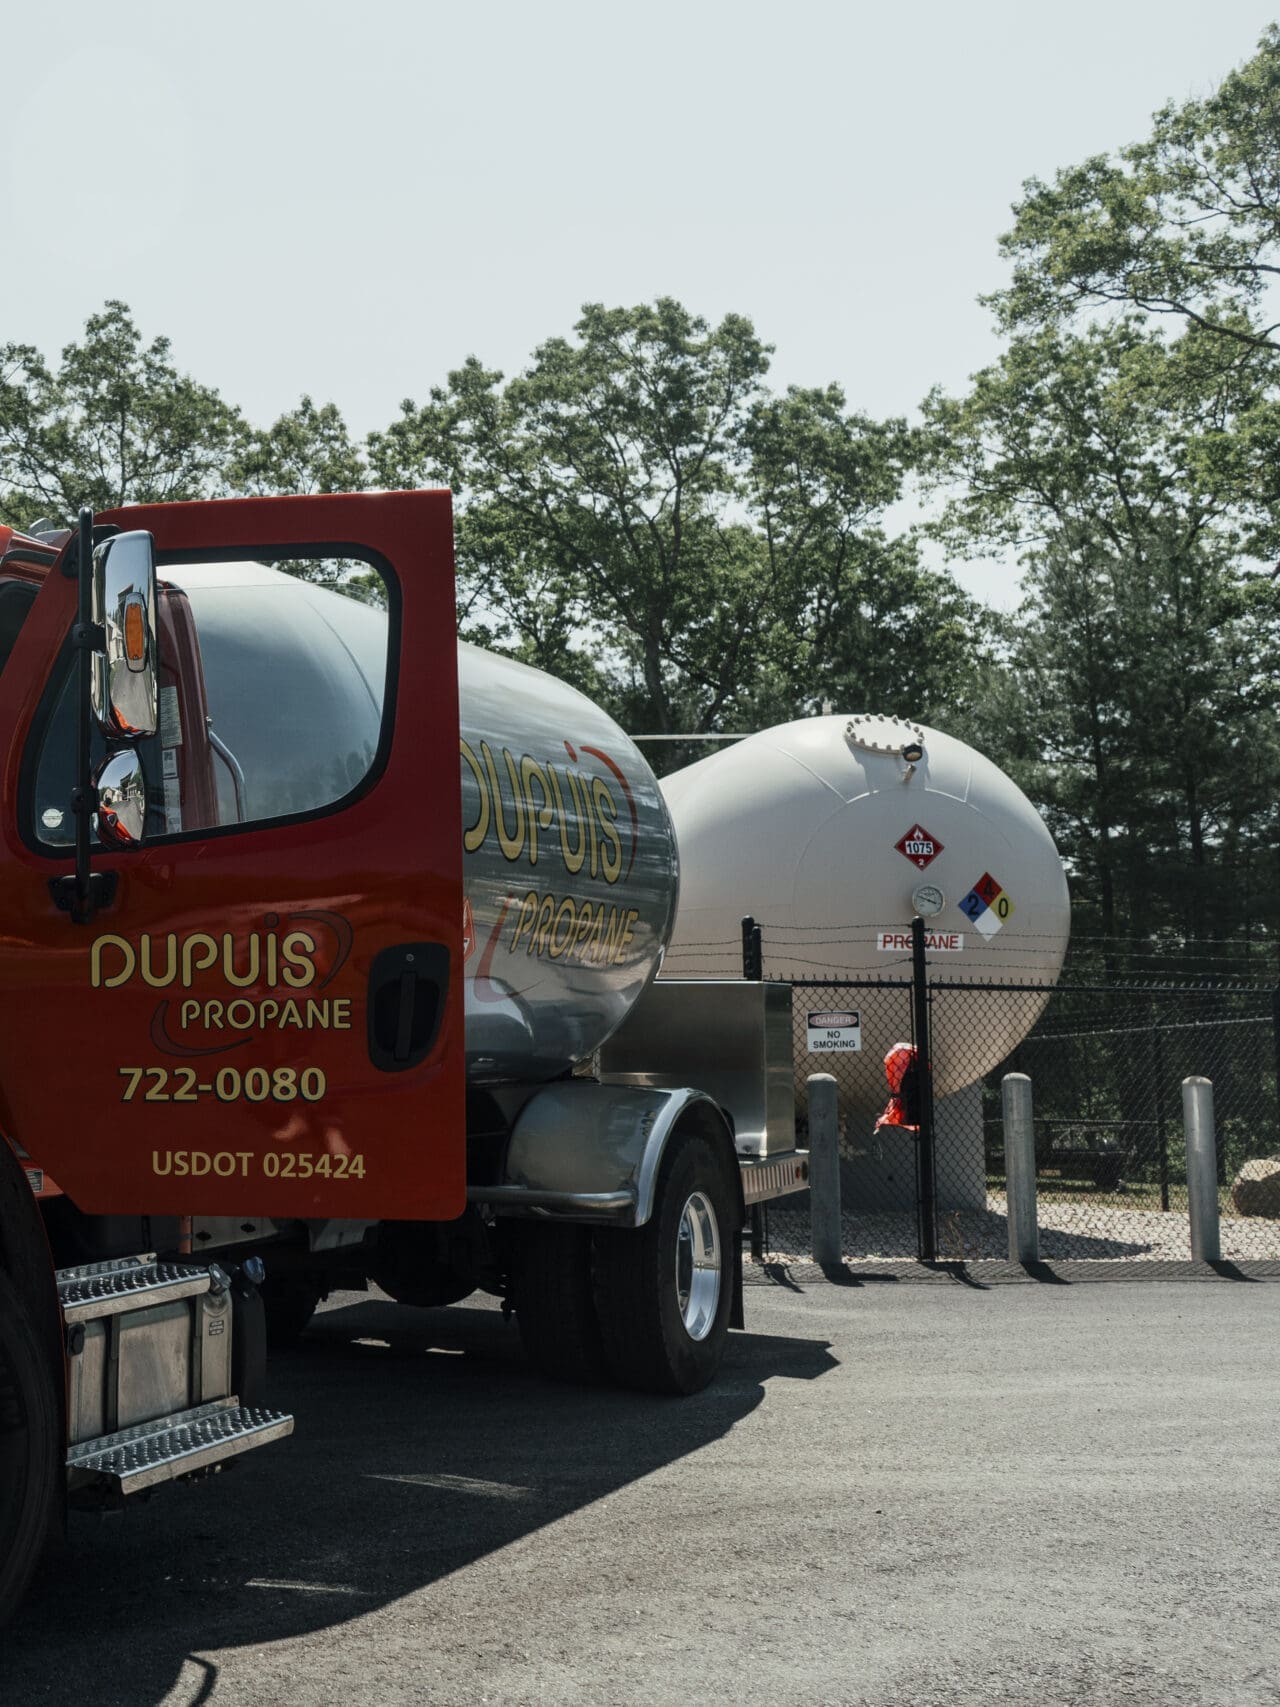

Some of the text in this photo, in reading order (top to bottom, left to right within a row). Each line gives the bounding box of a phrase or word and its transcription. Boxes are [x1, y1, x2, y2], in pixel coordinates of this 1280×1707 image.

[907, 842, 933, 854] 1075
[918, 858, 925, 866] 2
[983, 879, 995, 896] 4
[968, 895, 1009, 918] 2 0
[509, 890, 639, 966] PROPANE
[181, 999, 352, 1030] PROPANE
[815, 1016, 852, 1025] DANGER
[827, 1030, 841, 1039] NO
[813, 1040, 856, 1049] SMOKING
[118, 1066, 327, 1103] 722-0080
[152, 1150, 368, 1179] USDOT 025424
